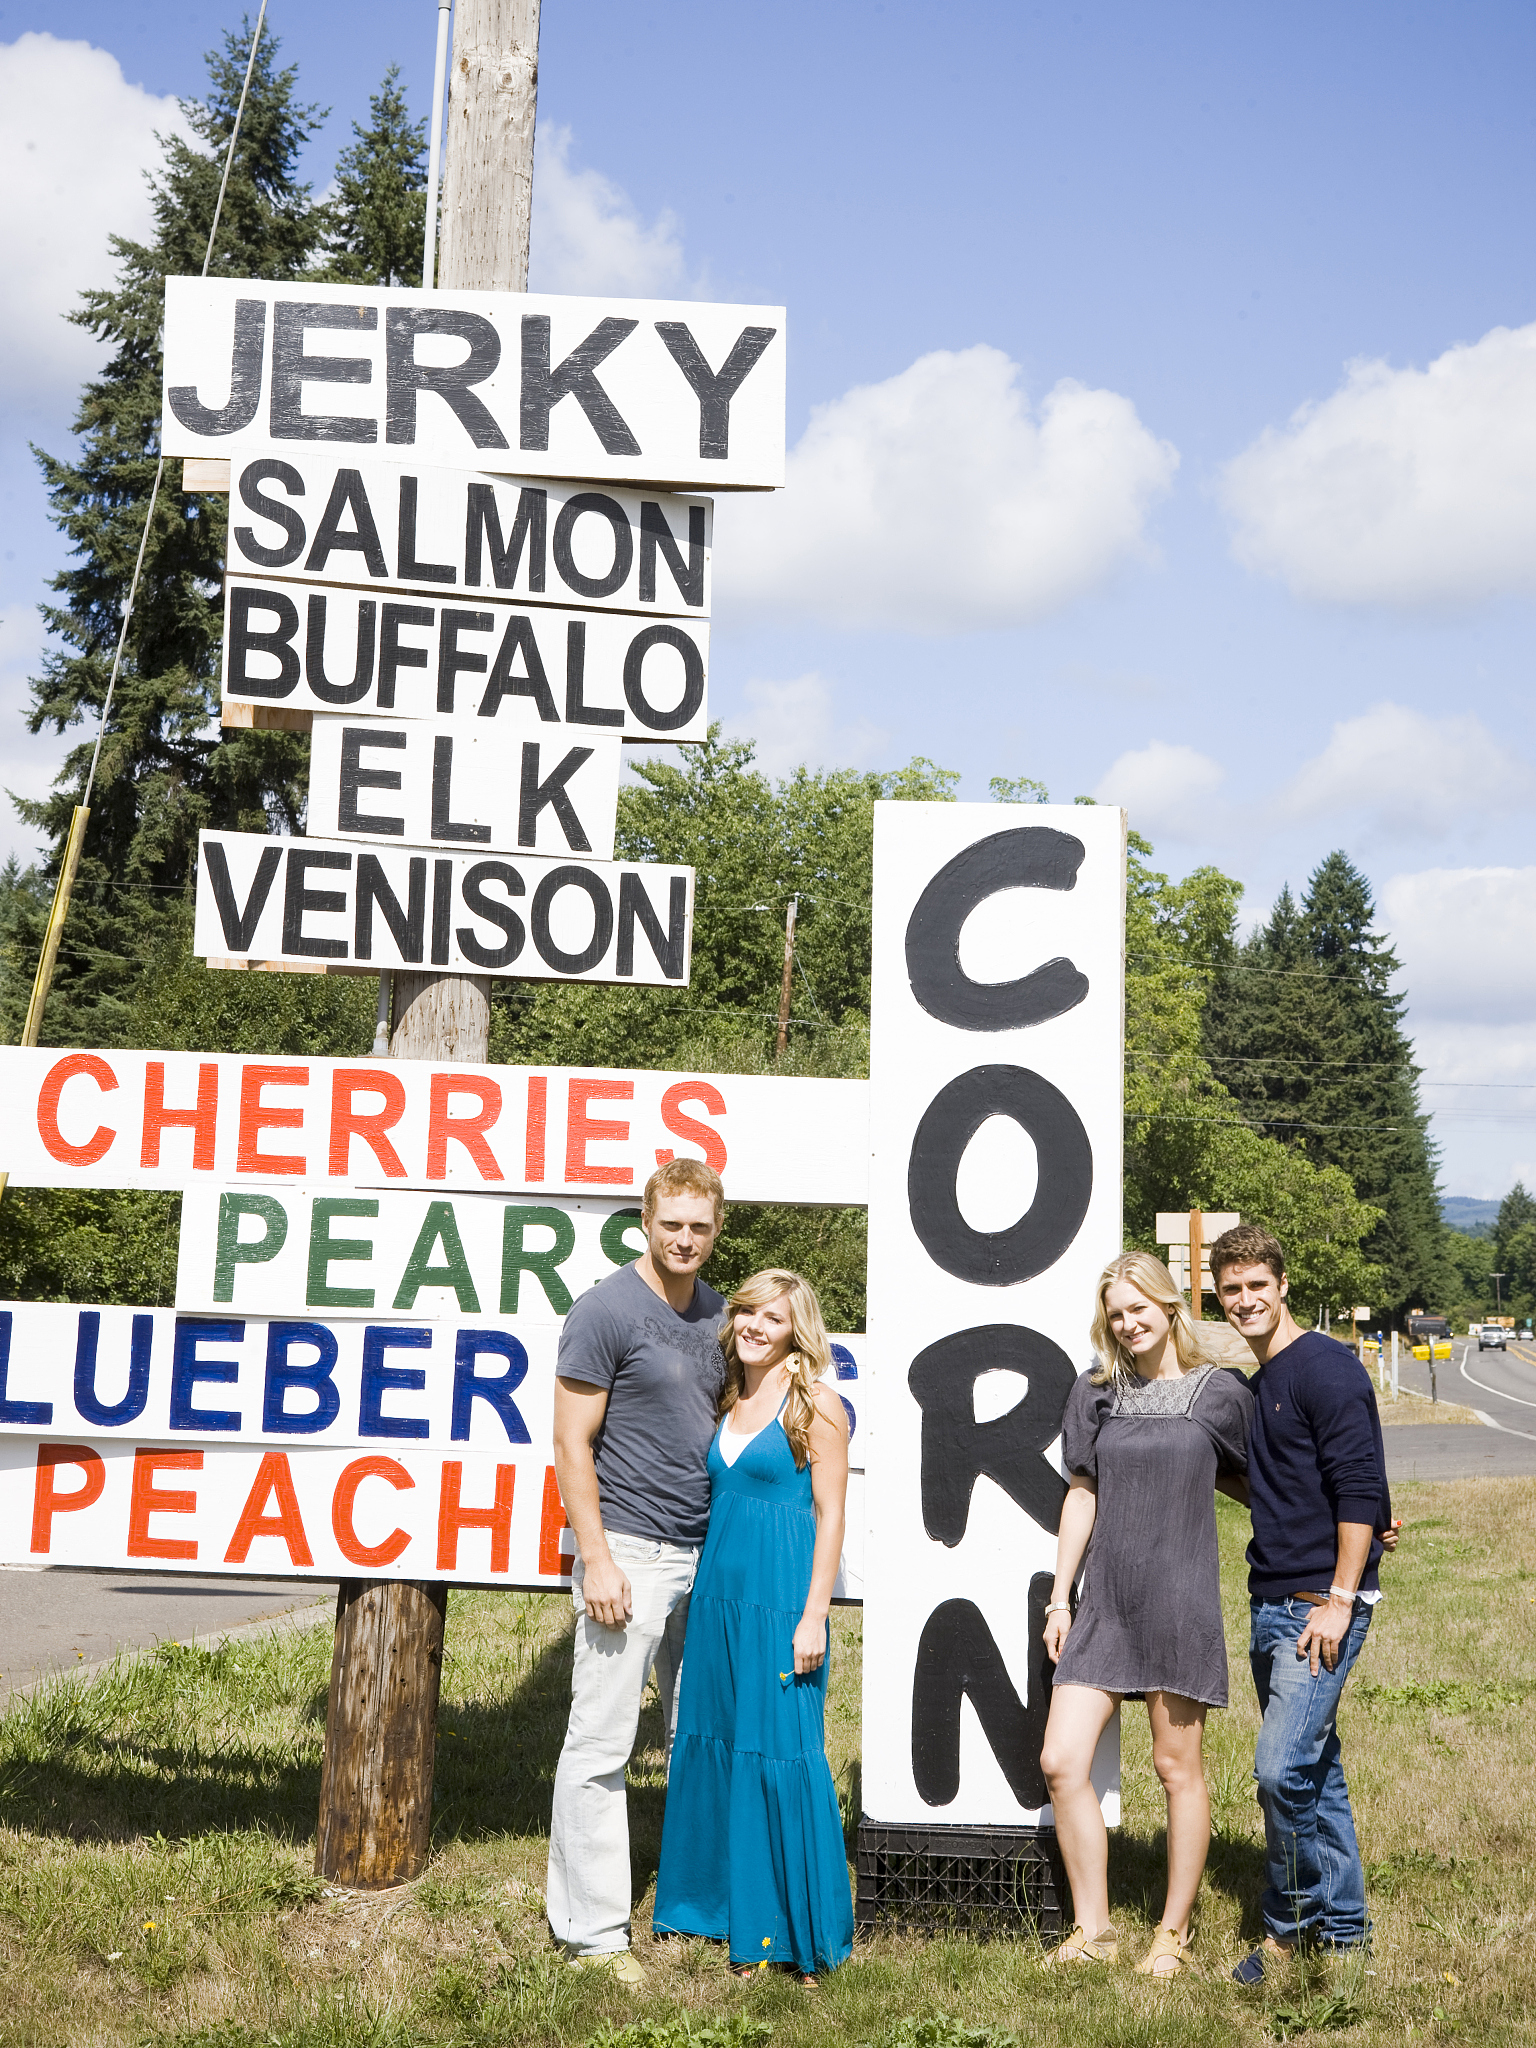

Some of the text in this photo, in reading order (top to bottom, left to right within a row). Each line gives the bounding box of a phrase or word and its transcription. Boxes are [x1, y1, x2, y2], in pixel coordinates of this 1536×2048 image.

[168, 299, 776, 459] JERKY
[234, 459, 705, 607] SALMON
[227, 587, 704, 731] BUFFALO
[338, 727, 594, 851] ELK
[202, 841, 686, 979] VENISON
[37, 1054, 727, 1185] CHERRIES
[905, 826, 1091, 1811] CORN
